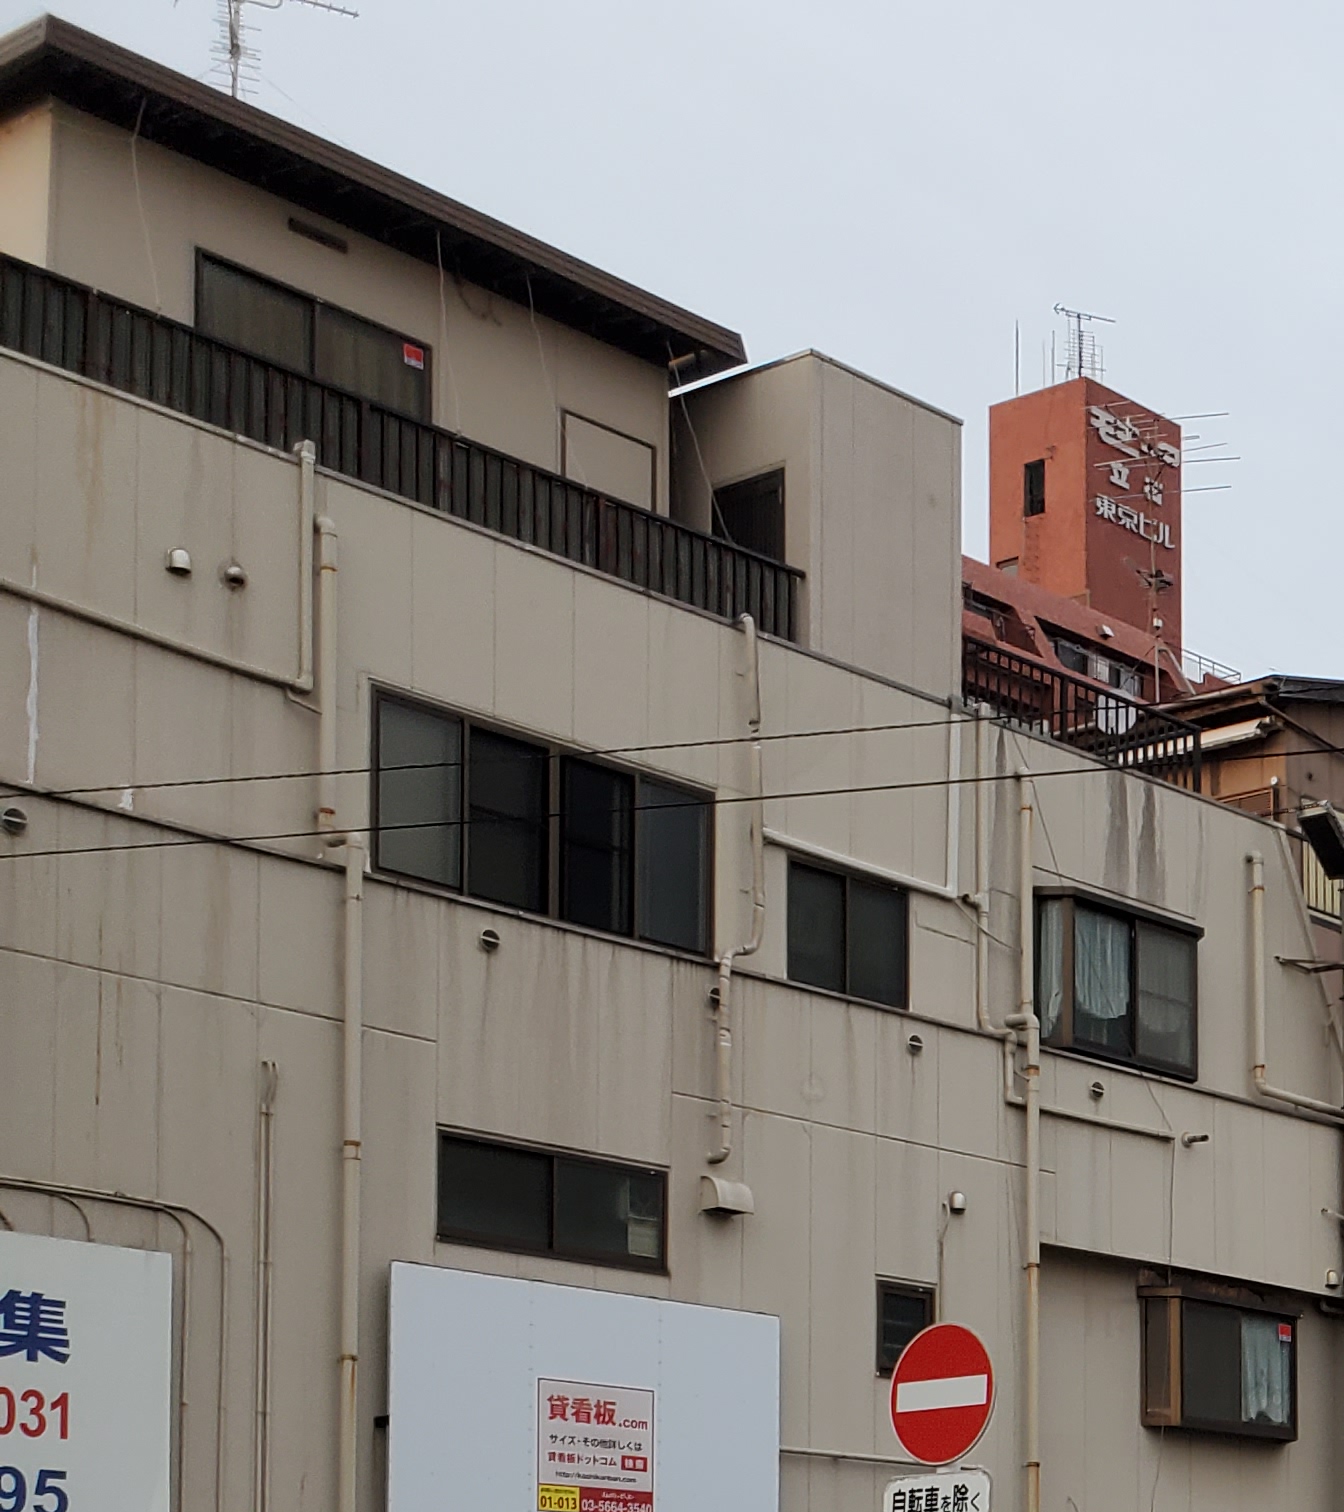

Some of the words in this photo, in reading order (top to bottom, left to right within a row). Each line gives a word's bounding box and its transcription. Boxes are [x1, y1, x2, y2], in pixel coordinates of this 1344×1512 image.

[1095, 493, 1176, 549] 東京ビル
[547, 1451, 617, 1467] 貸看板ドットコム
[540, 1495, 578, 1510] 01-013
